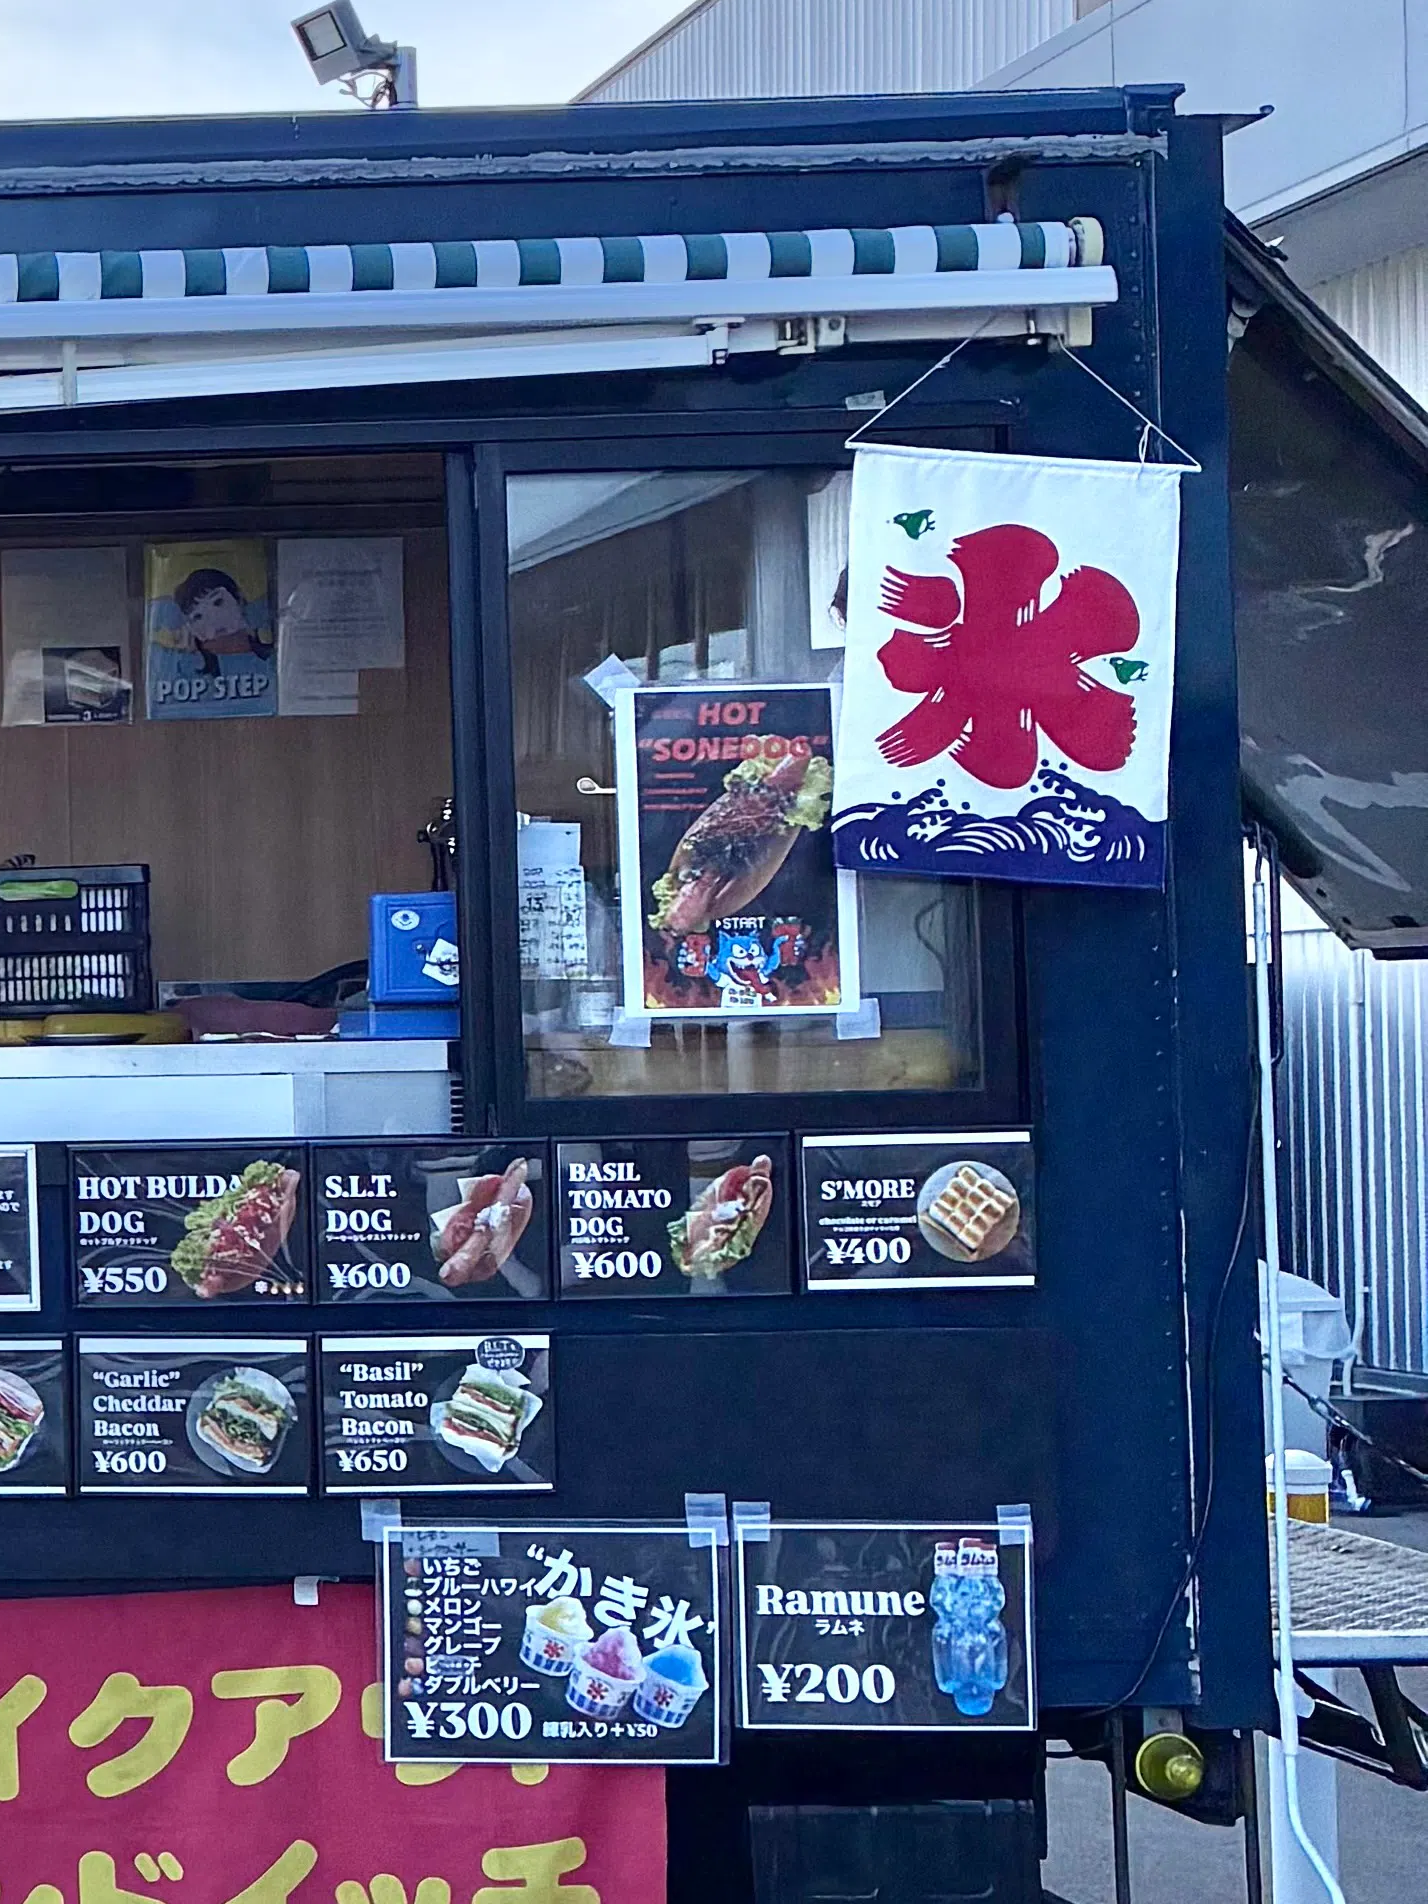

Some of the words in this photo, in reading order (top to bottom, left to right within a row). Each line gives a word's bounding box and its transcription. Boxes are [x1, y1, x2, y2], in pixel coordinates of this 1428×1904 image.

[875, 524, 1141, 790] 氷
[156, 678, 208, 704] POP
[213, 673, 270, 702] STEP
[697, 701, 768, 726] HOT
[722, 916, 766, 929] START
[568, 1162, 641, 1182] BASIL
[77, 1176, 141, 1199] HOT
[325, 1175, 397, 1198] S.L.T.
[568, 1189, 672, 1209] TOMATO
[79, 1210, 145, 1234] DOG
[326, 1209, 392, 1232] DOG
[569, 1217, 624, 1236] DOG
[824, 1237, 911, 1265] ¥400
[326, 1262, 412, 1289] ¥600
[571, 1250, 662, 1279] ¥600
[81, 1266, 168, 1294] ¥550
[92, 1369, 181, 1388] “Garlic”
[339, 1361, 424, 1382] “Basil”
[92, 1394, 187, 1413] Cheddar
[339, 1390, 429, 1409] Tomato
[93, 1419, 160, 1437] Bacon
[341, 1417, 415, 1437] Bacon
[92, 1450, 167, 1473] ¥600
[336, 1449, 408, 1472] ¥650
[423, 1557, 482, 1576] いちご
[423, 1577, 537, 1596] ブルーハワイ
[423, 1597, 482, 1615] メロン
[755, 1584, 926, 1617] Ramune
[423, 1617, 503, 1635] マンゴー
[814, 1618, 866, 1637] ラムネ
[423, 1676, 541, 1695] ダブルベリー
[756, 1663, 896, 1704] ¥200
[403, 1701, 533, 1740] ¥300
